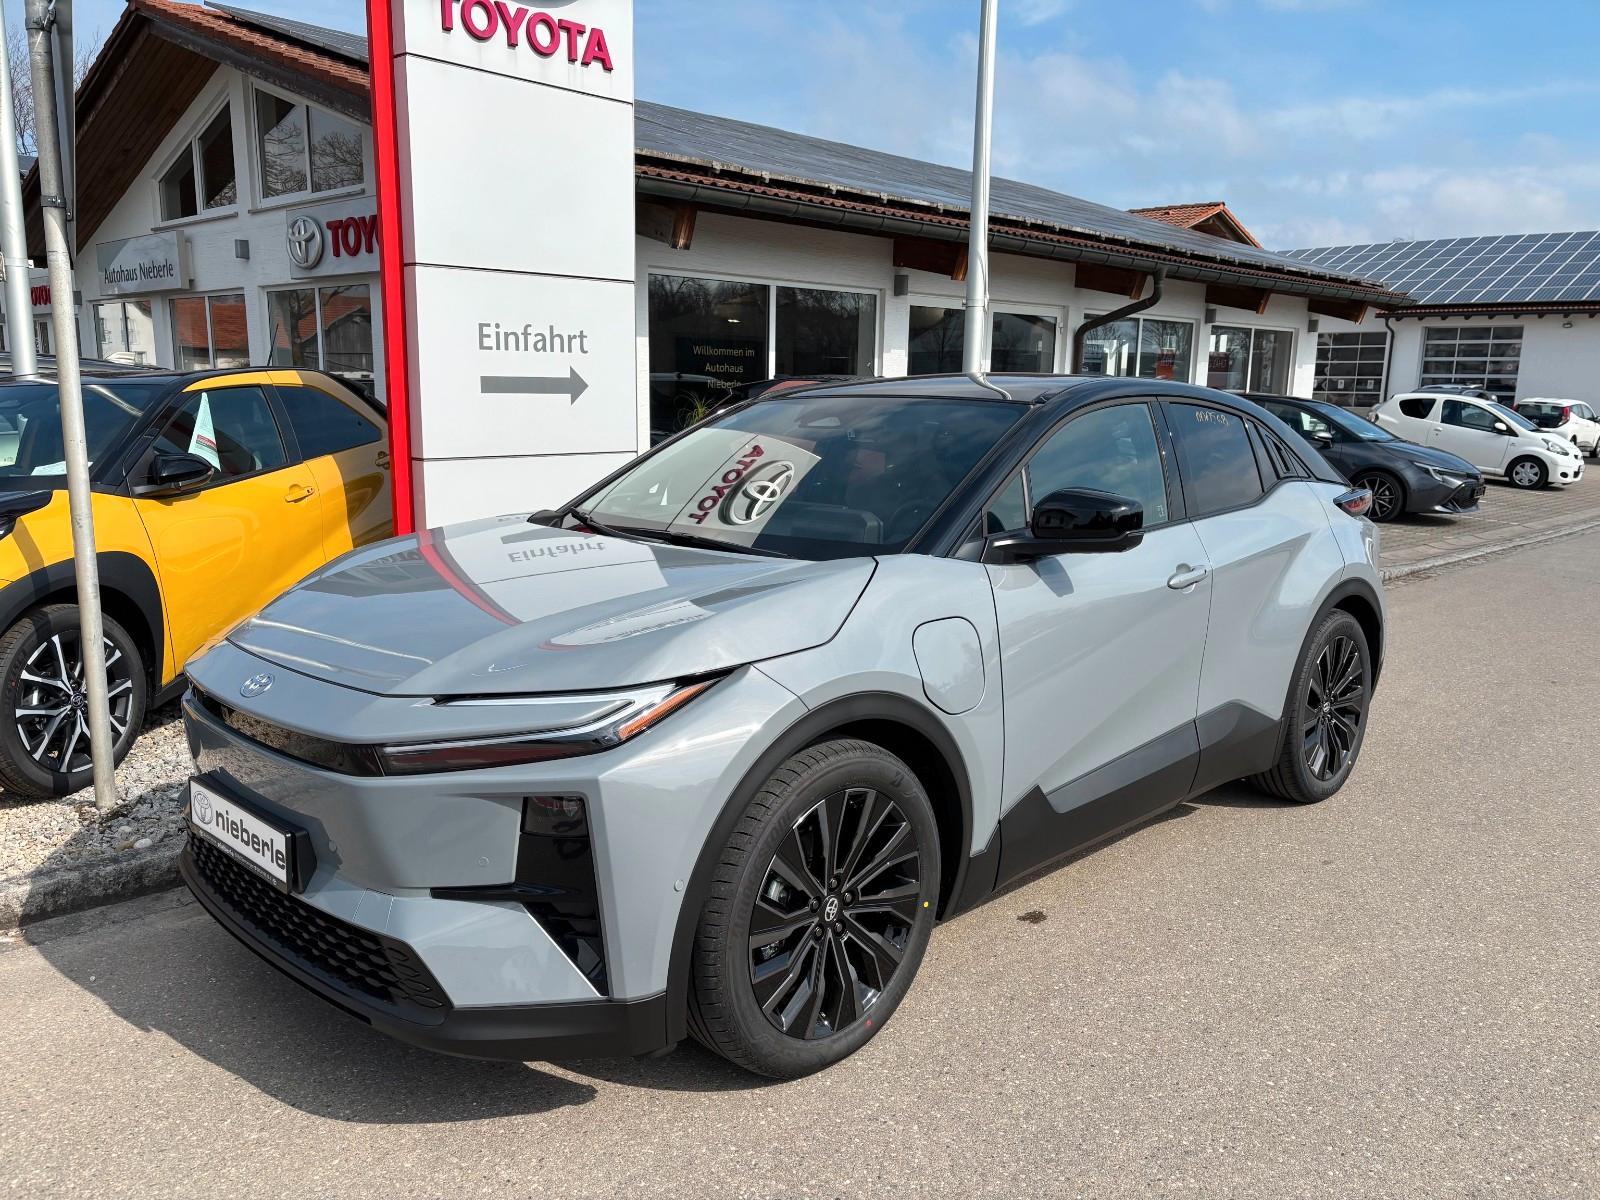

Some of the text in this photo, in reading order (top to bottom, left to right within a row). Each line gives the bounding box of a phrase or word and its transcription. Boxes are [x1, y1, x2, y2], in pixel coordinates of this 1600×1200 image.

[441, 0, 614, 71] TOYOTA
[326, 214, 381, 257] TOY
[104, 258, 174, 285] Autohaus Nieberle
[478, 322, 589, 354] Einfahrt
[693, 345, 755, 357] Willkommen im
[705, 363, 744, 373] Autohaus
[215, 809, 286, 871] nieberle
